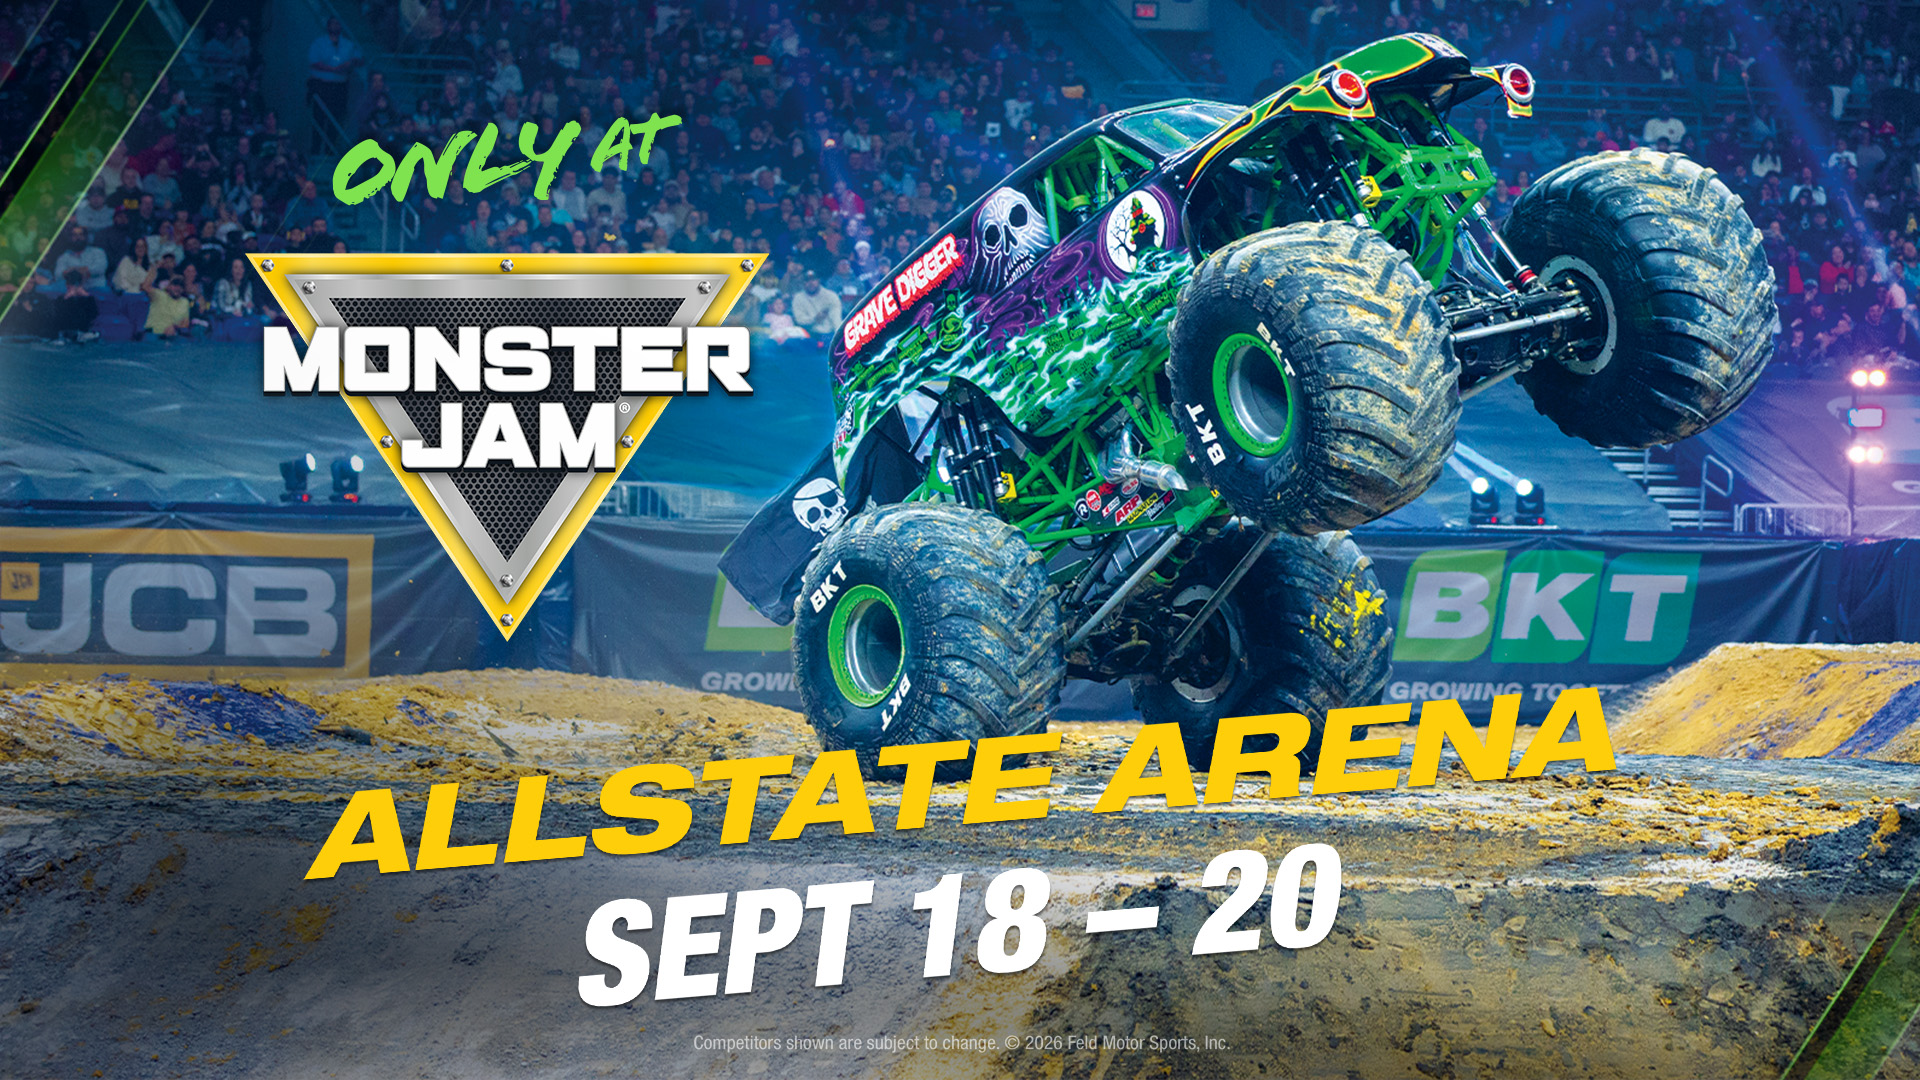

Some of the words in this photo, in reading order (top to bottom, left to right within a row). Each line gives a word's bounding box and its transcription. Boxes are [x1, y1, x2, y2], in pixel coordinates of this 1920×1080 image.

[844, 283, 900, 354] GRAVE
[894, 234, 962, 308] DIGGER
[1256, 321, 1296, 377] BKT
[1185, 403, 1227, 466] BKT
[1115, 494, 1140, 523] ARP
[0, 562, 338, 657] JCB
[810, 560, 848, 613] BKT
[1405, 571, 1689, 642] BKT
[881, 673, 912, 732] BKT
[1389, 681, 1523, 702] GROWING
